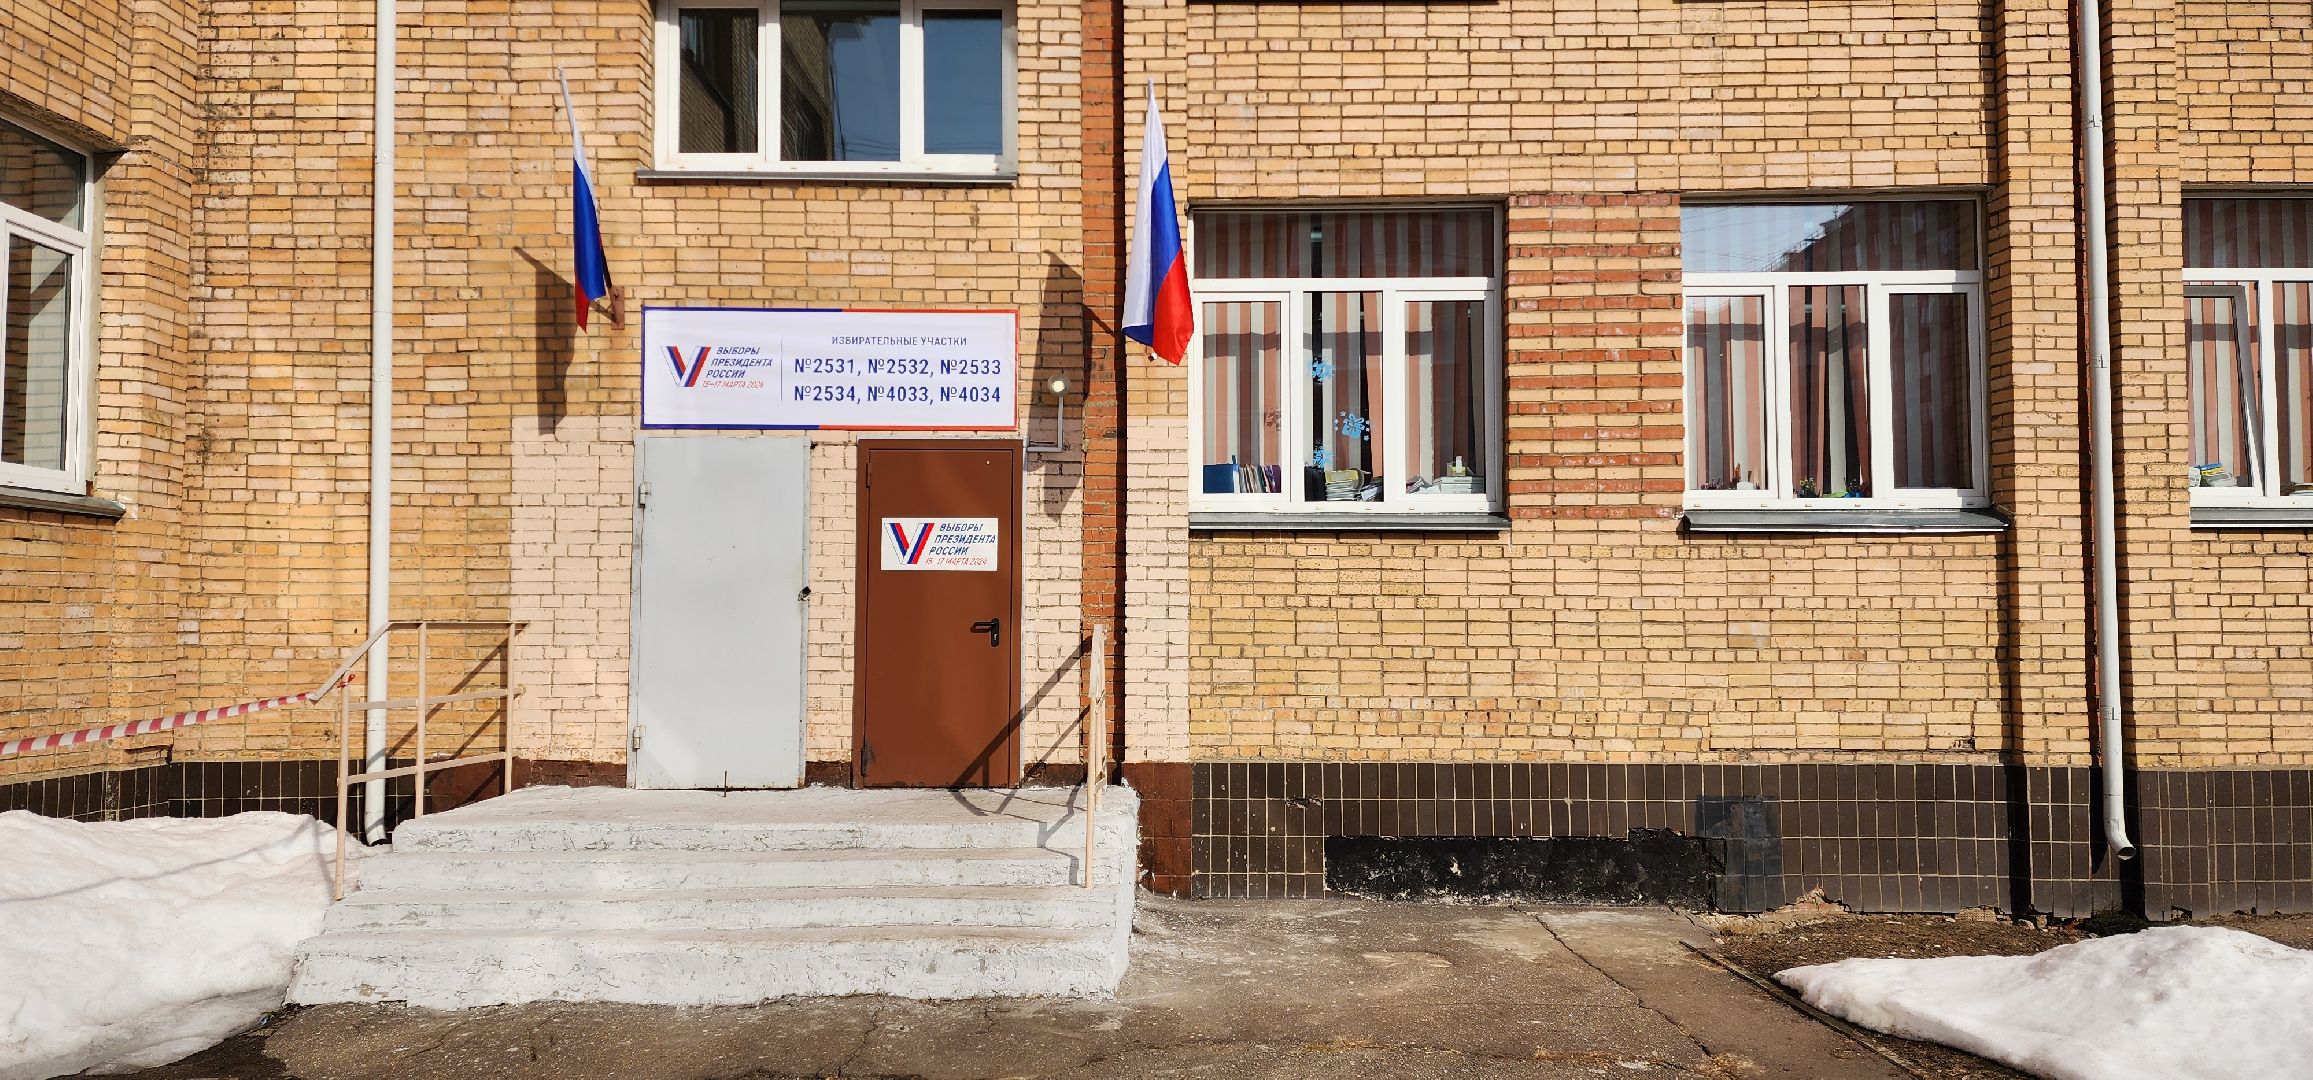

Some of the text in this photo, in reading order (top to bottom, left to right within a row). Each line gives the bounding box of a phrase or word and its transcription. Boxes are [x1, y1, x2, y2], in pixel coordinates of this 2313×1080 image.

[831, 336, 968, 346] ИЗБИРАТЕЛЬНЫЕ УЧАСТКИ
[716, 346, 760, 355] ВЫБОРЫ
[710, 358, 773, 368] ПРЕЗИДЕНТА
[794, 358, 1001, 378] №2531, №2532, №2533
[705, 369, 746, 379] РОССИИ
[722, 380, 746, 389] МАРТА
[794, 385, 1001, 406] №2534, №4033, №4034
[939, 523, 984, 532] ВЫБОРЫ
[934, 535, 996, 544] ПРЕЗИДЕНТА
[928, 547, 969, 555] РОССИИ
